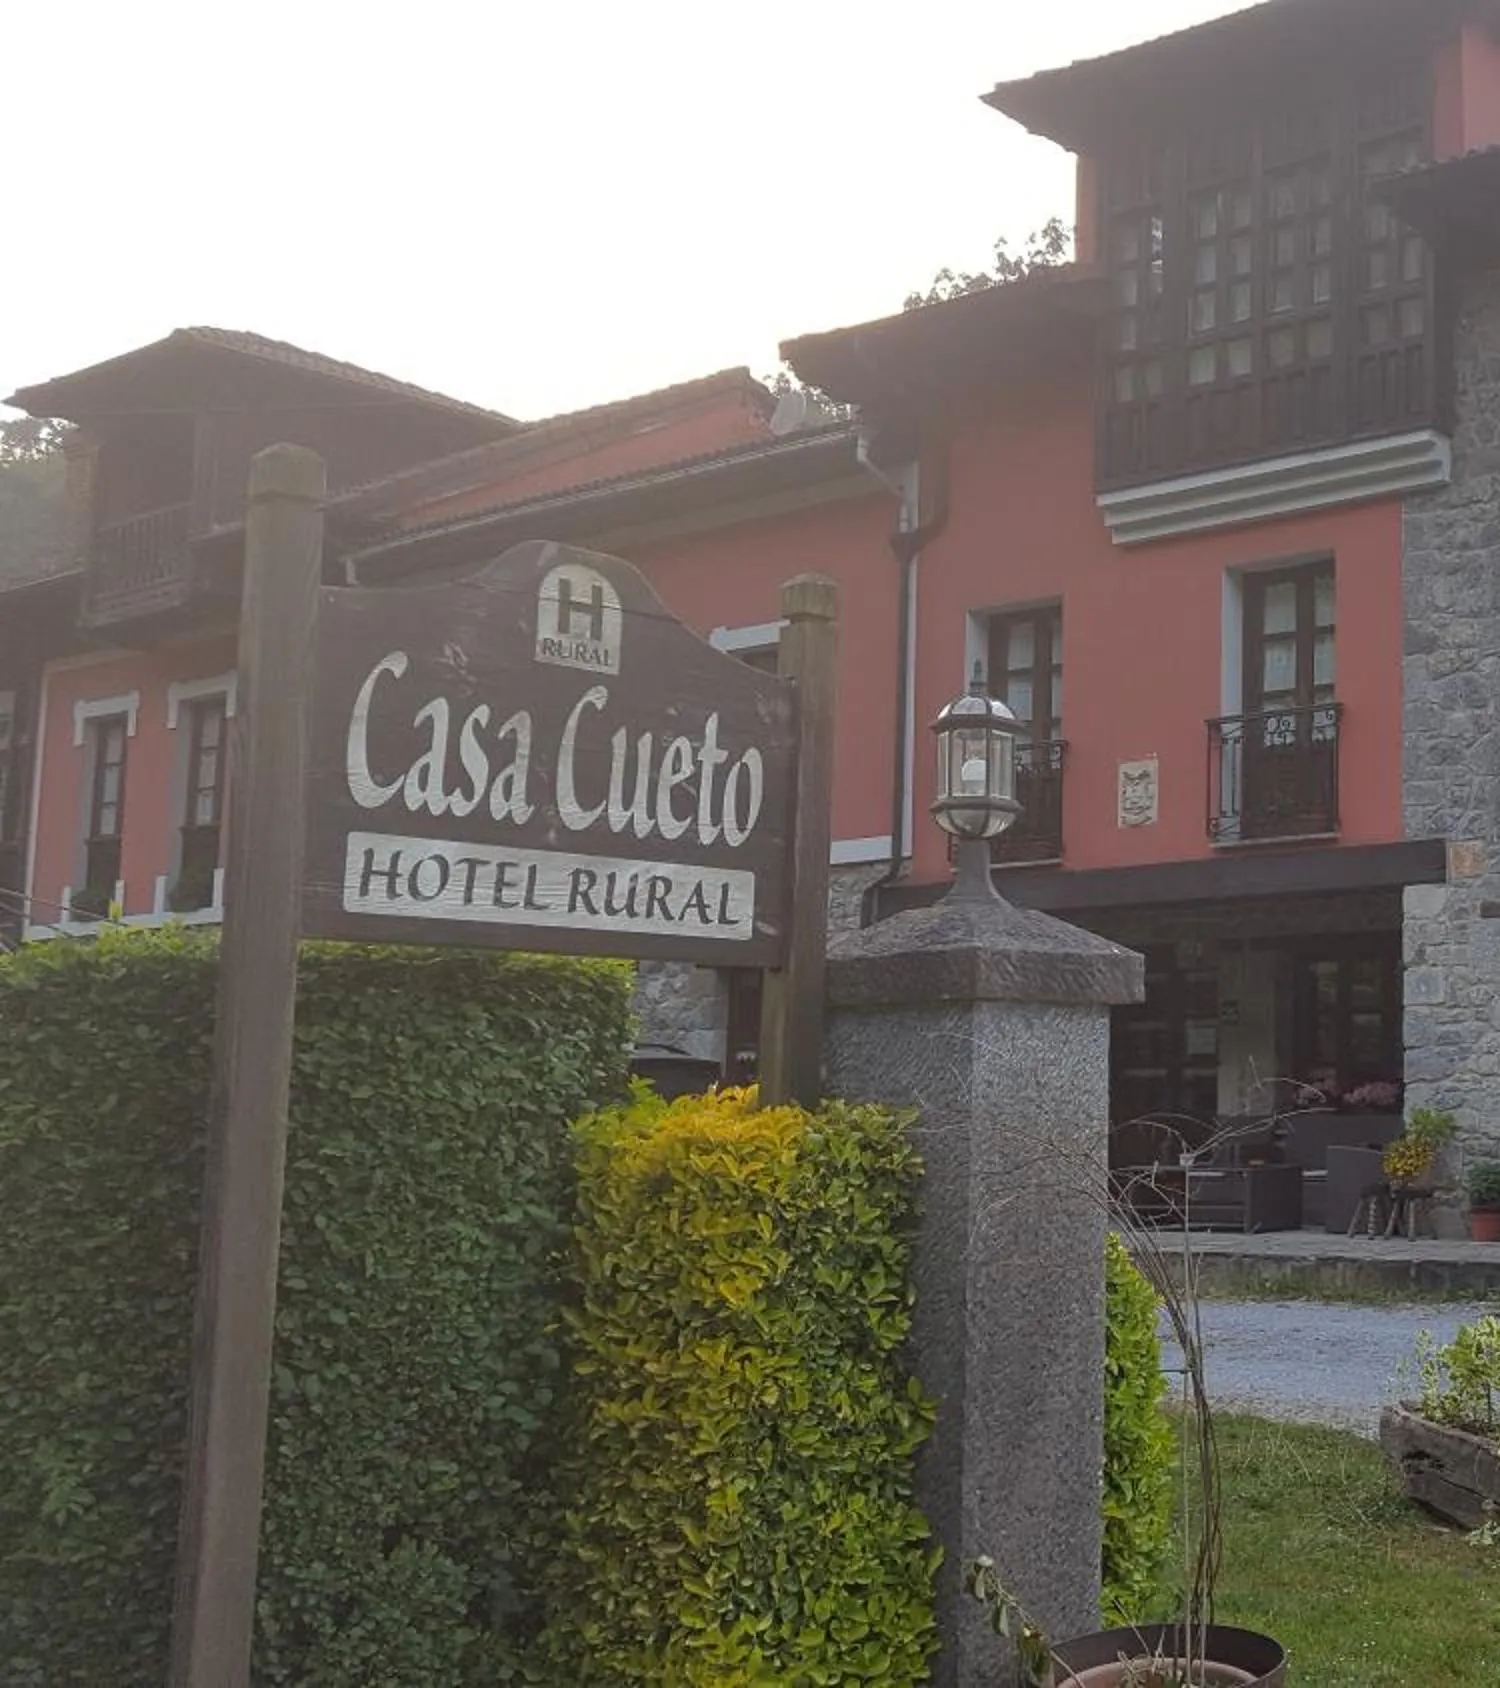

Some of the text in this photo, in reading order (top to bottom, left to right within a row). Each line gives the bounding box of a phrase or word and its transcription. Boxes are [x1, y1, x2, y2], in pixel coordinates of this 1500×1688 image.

[558, 577, 603, 641] H
[542, 637, 614, 667] RURAL
[347, 650, 763, 847] Casa Cueto
[358, 847, 740, 926] HOTEL RURAL
